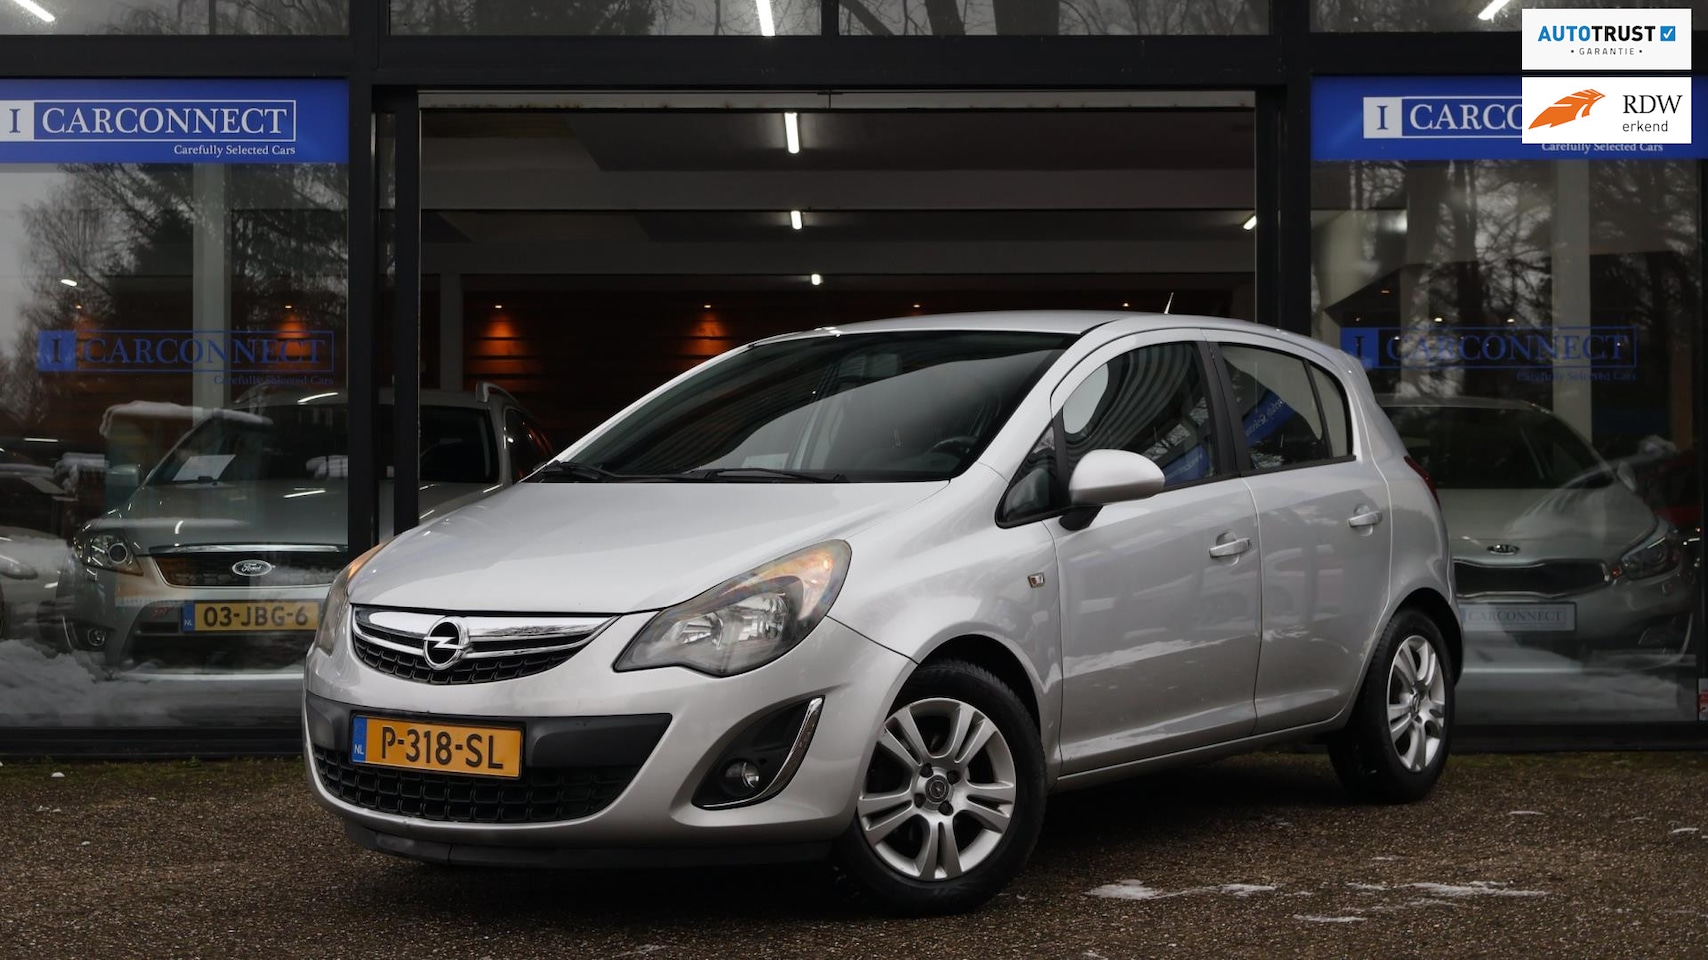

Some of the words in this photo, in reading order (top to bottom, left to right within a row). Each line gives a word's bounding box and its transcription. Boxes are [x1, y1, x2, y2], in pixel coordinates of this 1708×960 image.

[42, 106, 288, 134] CARCONNECT
[173, 144, 223, 158] Carefully
[226, 145, 269, 155] Selected
[271, 145, 296, 155] Cars
[84, 337, 326, 364] CARCONNECT
[1386, 334, 1630, 360] CARCONNECT
[184, 619, 193, 627] NL
[203, 606, 309, 627] 03-JBG-6
[353, 743, 365, 755] NL
[381, 726, 504, 769] P-318-SL
